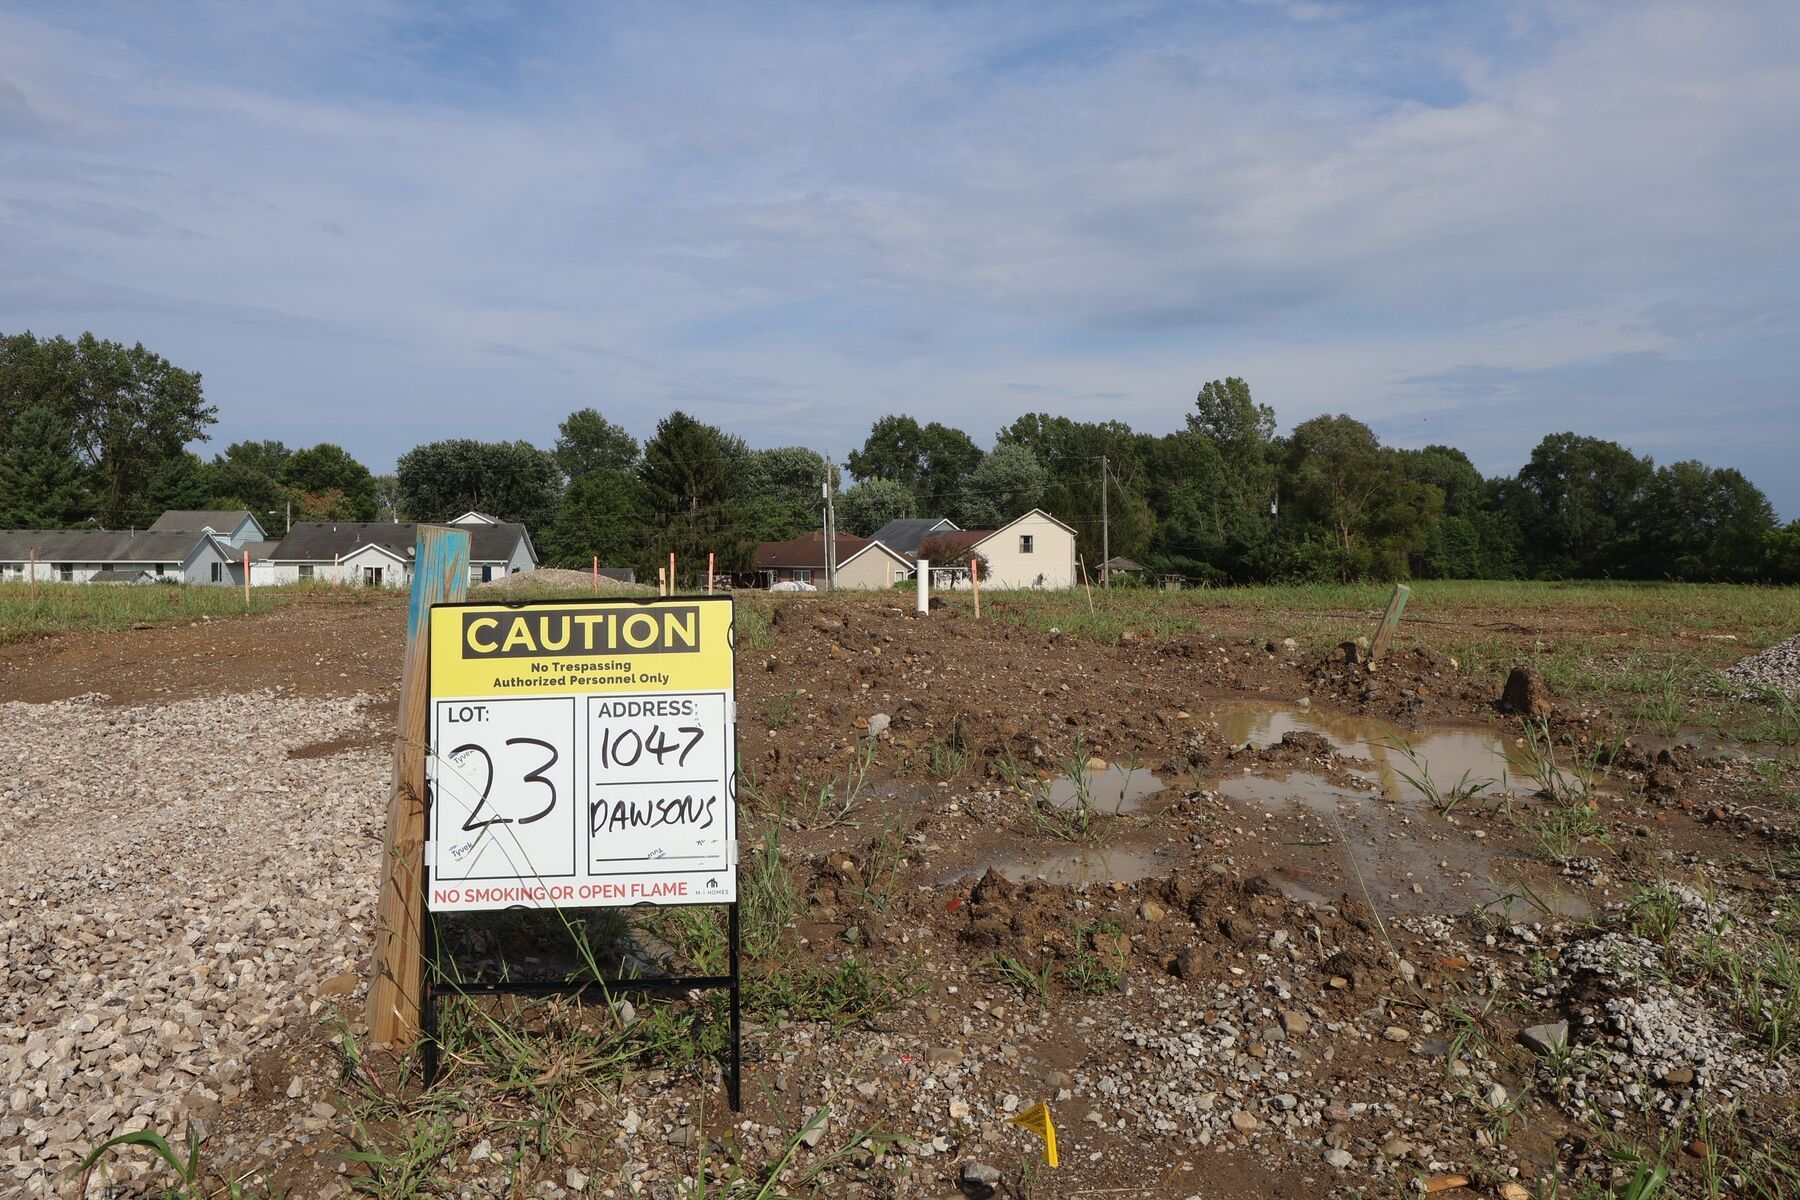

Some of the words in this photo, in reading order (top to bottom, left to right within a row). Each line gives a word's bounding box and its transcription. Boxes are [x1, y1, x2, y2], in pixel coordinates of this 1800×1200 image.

[467, 612, 695, 653] CAUTION
[531, 663, 548, 672] No
[552, 660, 632, 672] Trespassing
[493, 676, 566, 688] Authorized
[570, 674, 636, 686] Personnel
[640, 674, 669, 685] Only
[448, 706, 489, 722] LOT:
[598, 700, 698, 718] ADDRESS:
[601, 725, 704, 769] 1047
[447, 738, 558, 831] 23
[590, 795, 716, 838] DAWSONS
[434, 889, 460, 904] NO
[464, 886, 546, 903] SMOKING
[550, 886, 574, 900] OR
[578, 884, 627, 899] OPEN
[631, 882, 688, 897] FLAME
